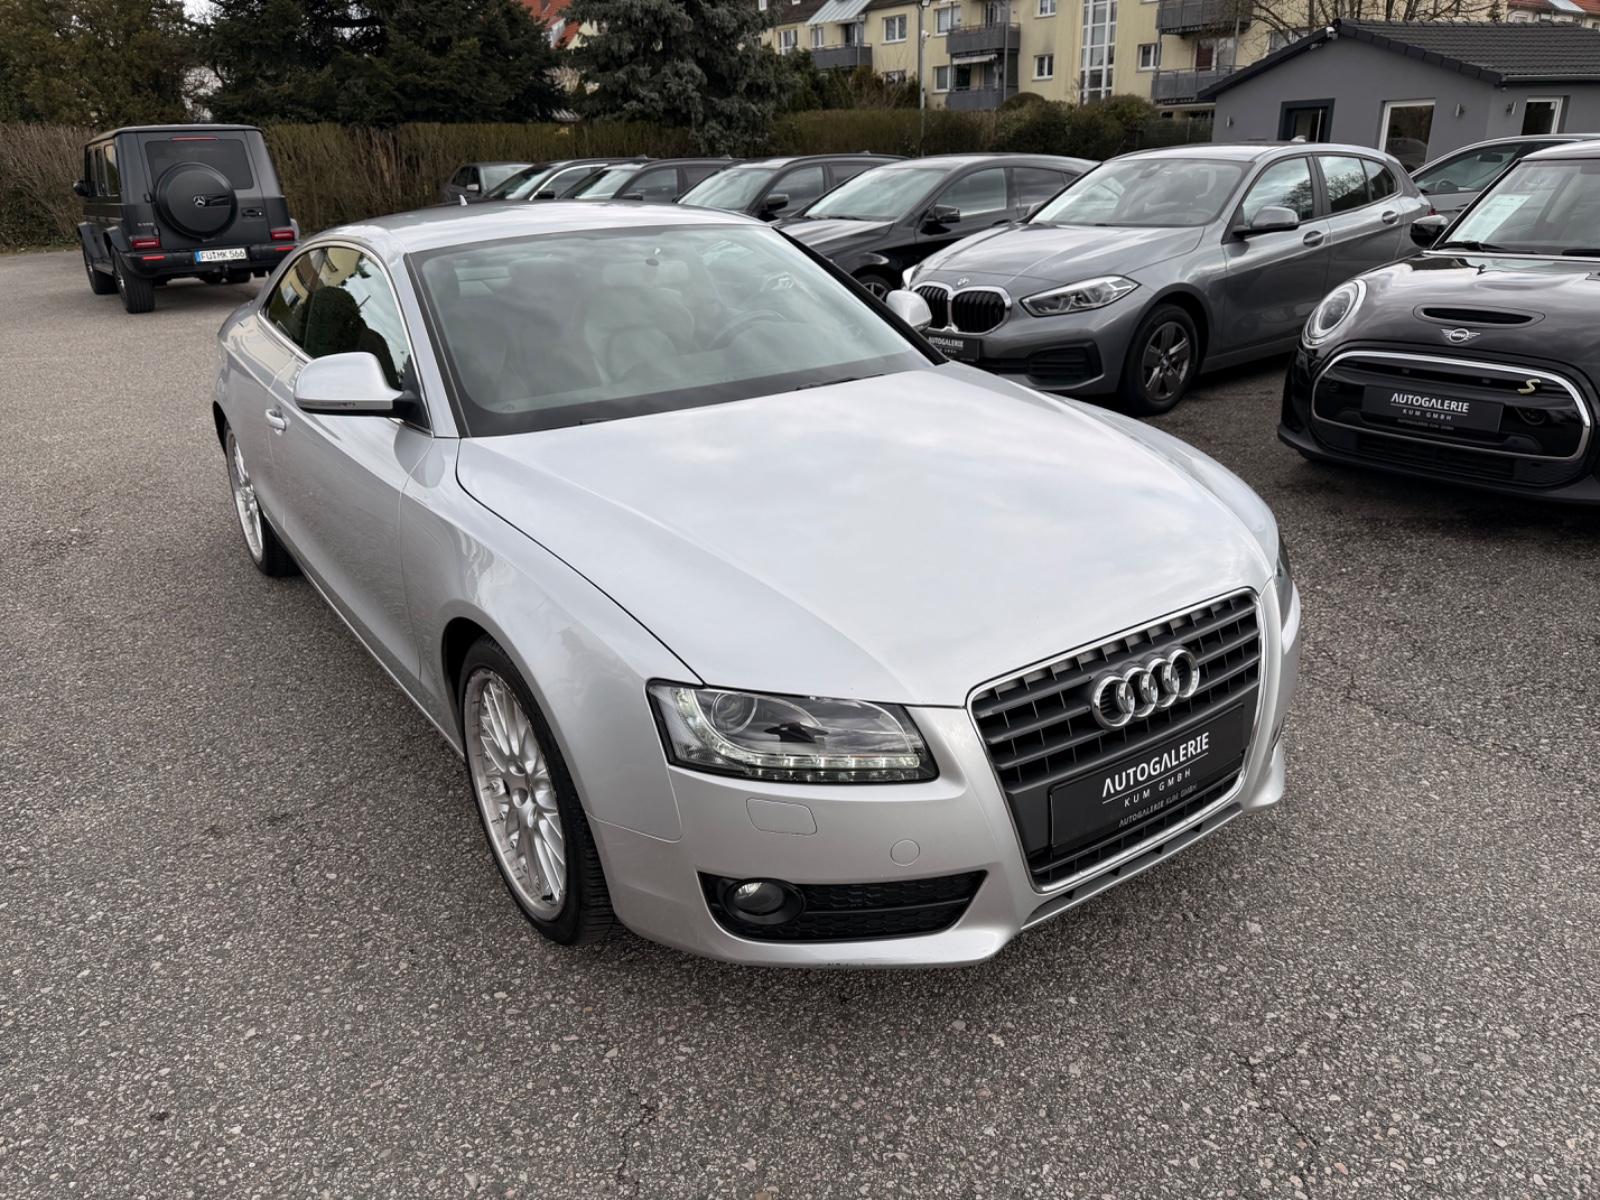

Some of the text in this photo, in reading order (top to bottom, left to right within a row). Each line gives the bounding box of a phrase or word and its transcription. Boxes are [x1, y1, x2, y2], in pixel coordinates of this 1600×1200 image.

[1517, 378, 1541, 394] S
[1390, 392, 1470, 413] AUTOGALERIE
[1402, 408, 1452, 421] KUM GMBH
[1102, 731, 1209, 798] AUTOGALERIE
[1124, 767, 1191, 808] KUM GMBH
